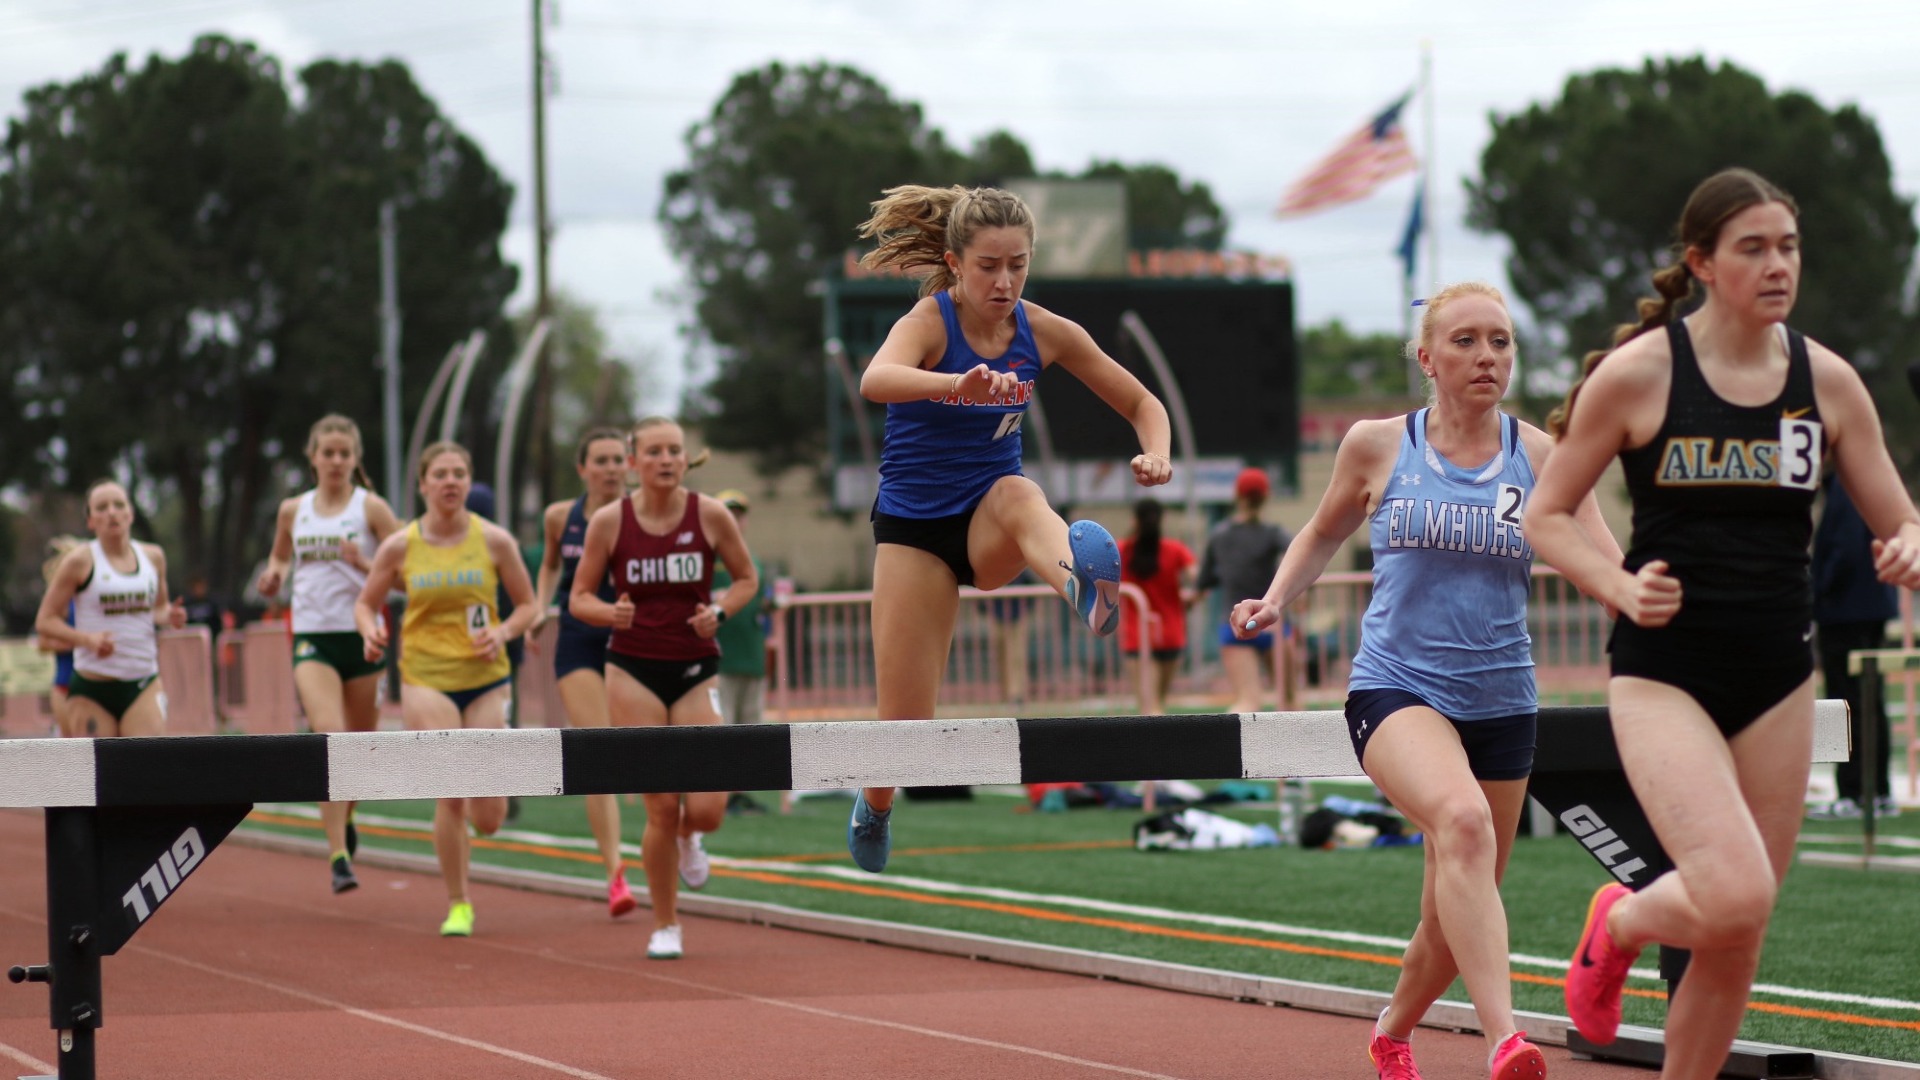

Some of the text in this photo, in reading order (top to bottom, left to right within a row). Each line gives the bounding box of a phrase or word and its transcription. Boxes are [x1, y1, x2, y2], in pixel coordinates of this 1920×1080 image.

[1656, 437, 1781, 487] ALAS
[1791, 424, 1813, 485] 3
[1501, 487, 1523, 525] 2
[626, 558, 668, 584] CHI
[672, 554, 698, 581] 10
[472, 605, 486, 629] 4
[1559, 803, 1648, 883] GILL
[121, 826, 205, 923] GILL
